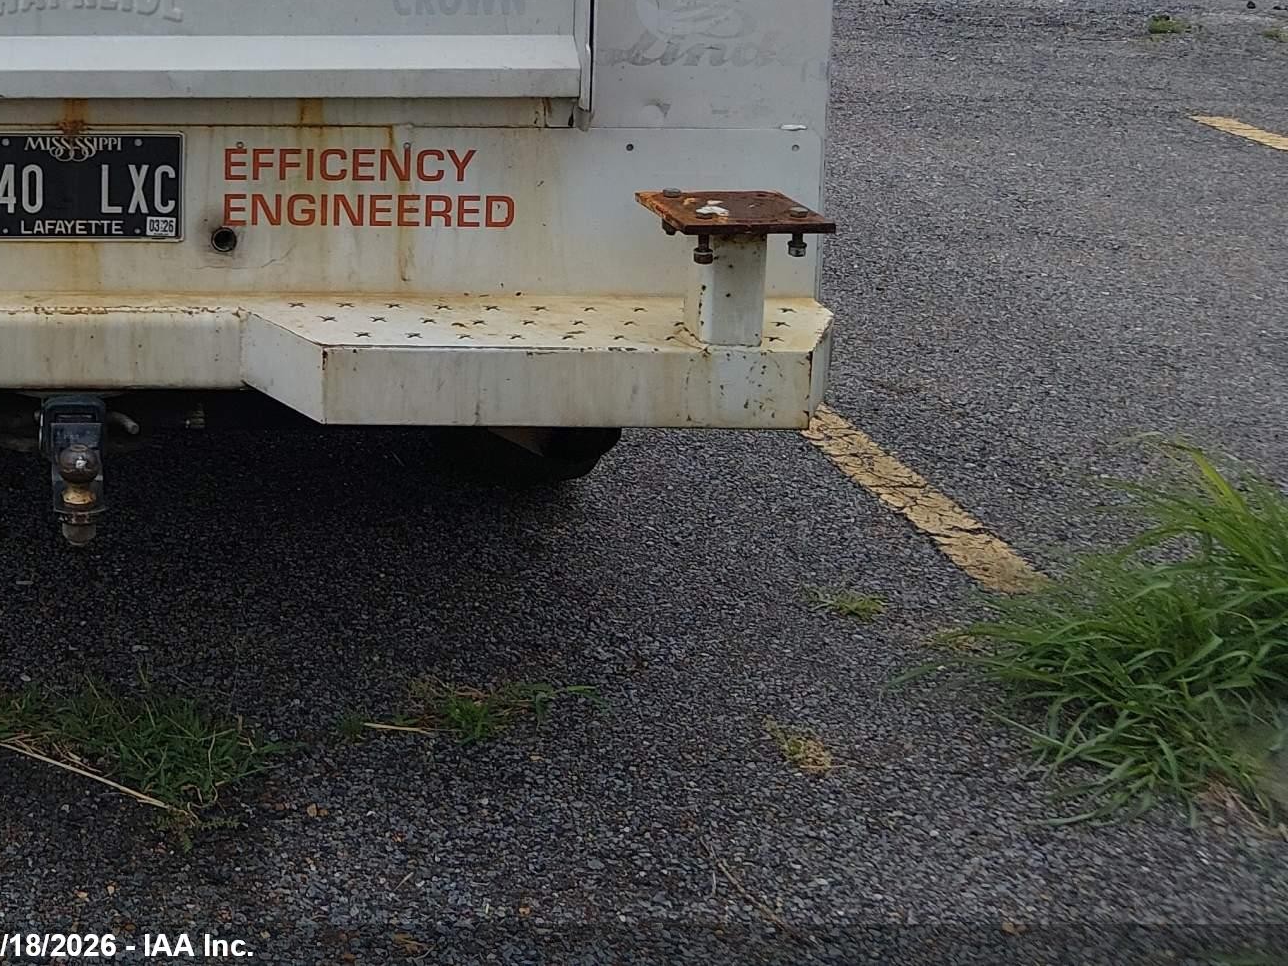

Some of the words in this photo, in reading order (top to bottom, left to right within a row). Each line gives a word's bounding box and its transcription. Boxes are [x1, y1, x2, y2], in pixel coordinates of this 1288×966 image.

[223, 147, 477, 182] EFFICENCY
[101, 163, 176, 214] LXC
[20, 219, 124, 235] LAFAYETTE
[223, 193, 516, 228] ENGINEERED
